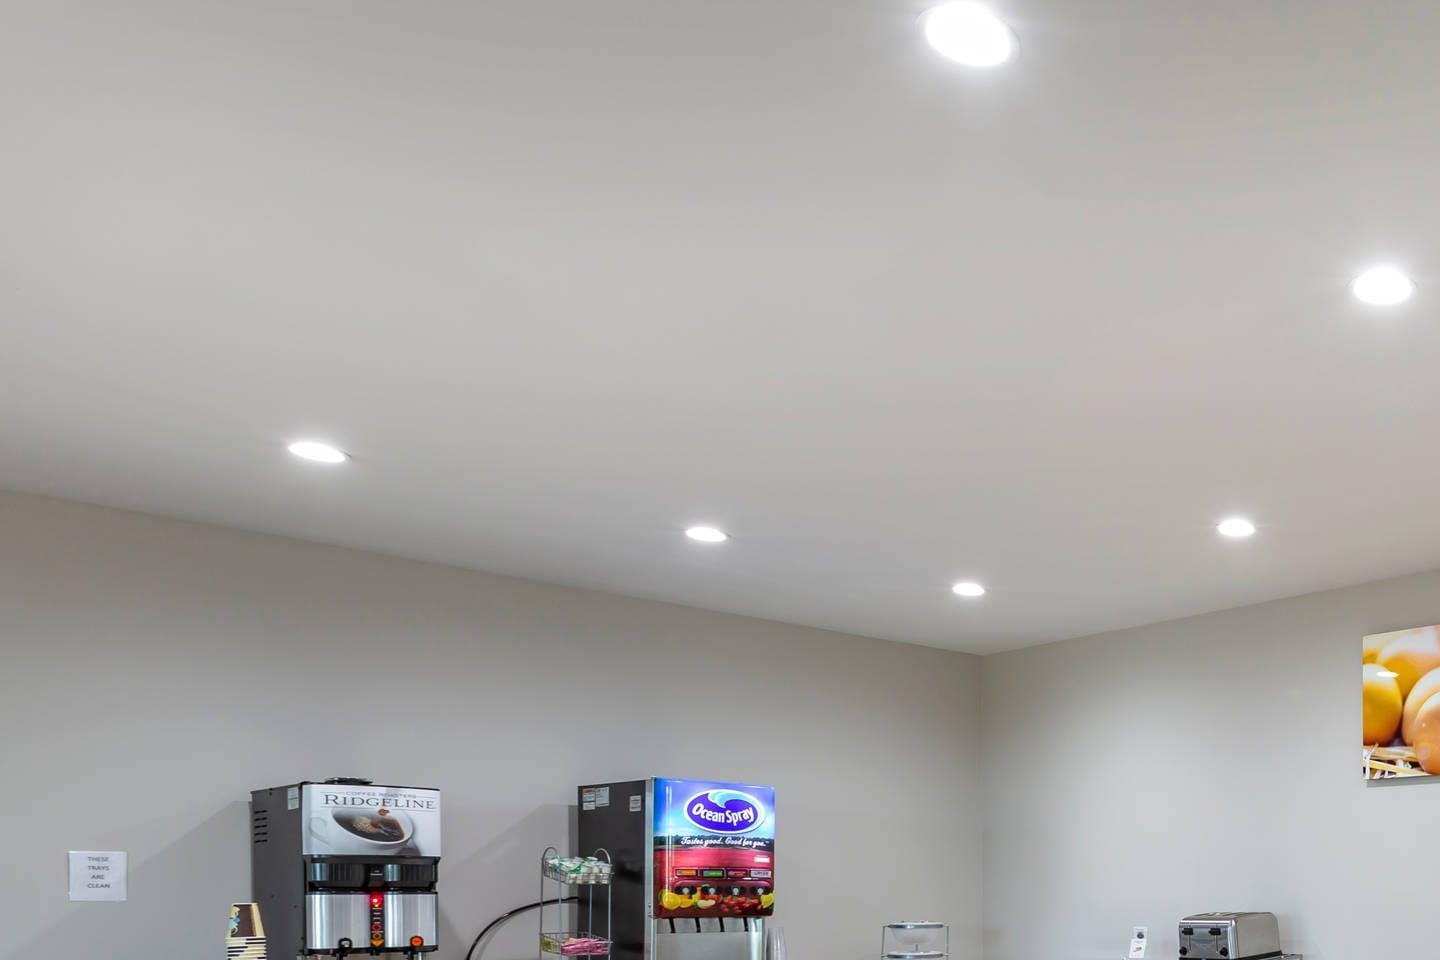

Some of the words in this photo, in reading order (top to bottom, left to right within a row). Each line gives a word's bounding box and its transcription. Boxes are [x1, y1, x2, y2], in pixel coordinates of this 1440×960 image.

[324, 794, 434, 809] RIDGELINE
[692, 803, 725, 823] Ocean
[726, 806, 755, 826] Spray
[681, 836, 704, 845] Tastes
[725, 837, 742, 845] Good
[742, 838, 753, 847] for
